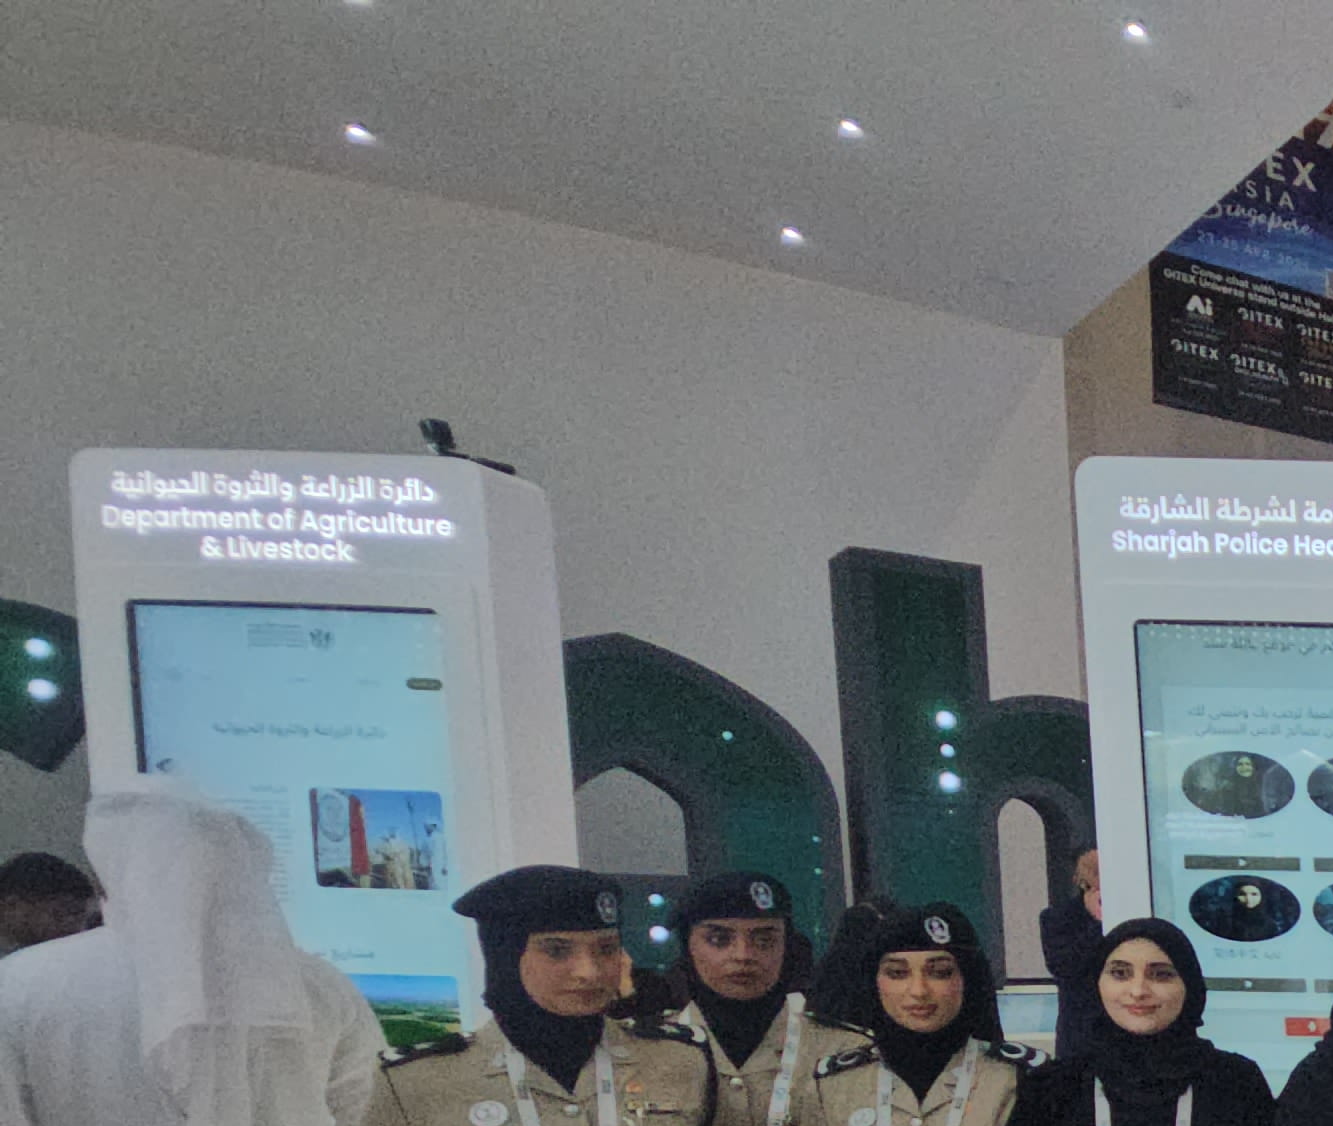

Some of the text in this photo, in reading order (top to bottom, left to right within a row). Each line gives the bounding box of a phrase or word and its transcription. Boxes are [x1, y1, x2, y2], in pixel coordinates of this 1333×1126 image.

[111, 470, 437, 505] دائرة الزراعة والثروة الحيوانية
[102, 504, 455, 539] Department of Agriculture
[1119, 493, 1210, 524] الشارقة
[1216, 495, 1297, 527] لشرطة
[200, 535, 354, 562] & Livestock
[1111, 528, 1209, 560] Sharjah
[1214, 531, 1288, 556] Police
